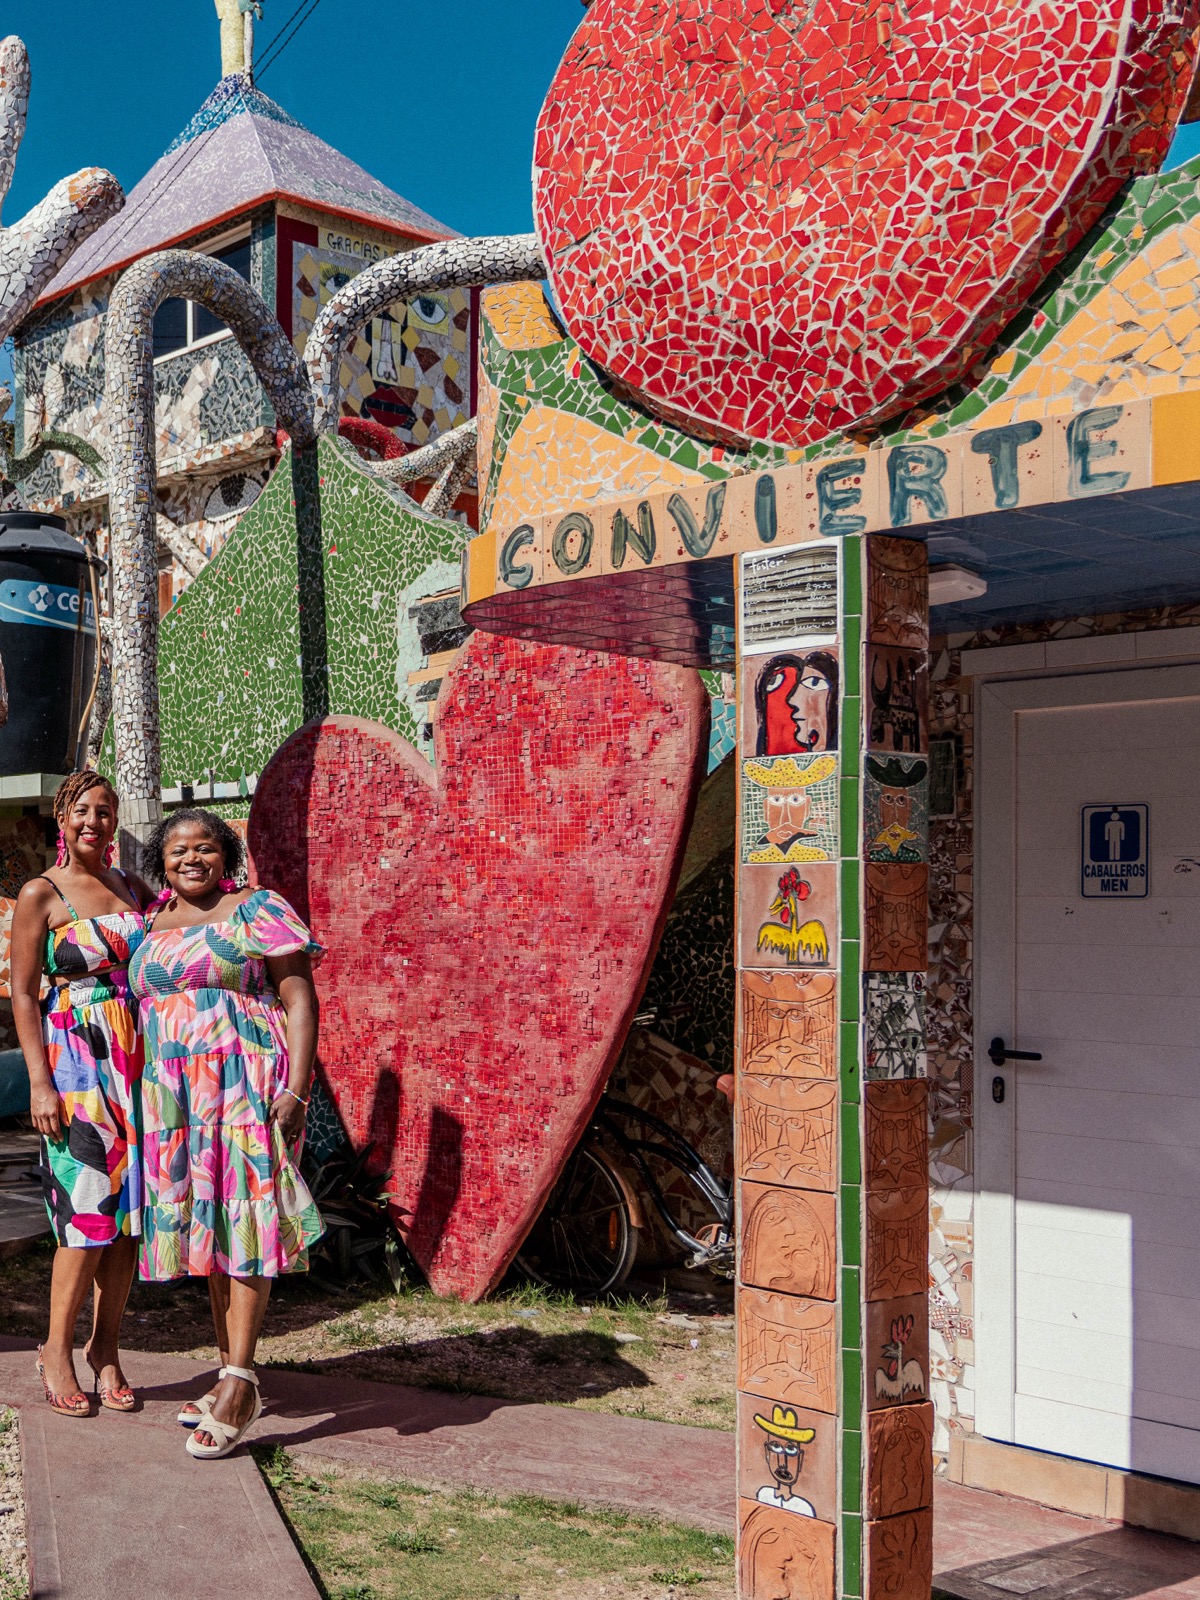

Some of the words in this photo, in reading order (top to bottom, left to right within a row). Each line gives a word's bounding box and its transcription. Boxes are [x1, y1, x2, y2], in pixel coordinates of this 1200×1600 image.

[327, 232, 380, 260] GRACIAS
[500, 405, 1131, 588] CONVIERTE
[1084, 864, 1145, 878] CABALLEROS
[1101, 879, 1128, 892] MEN
